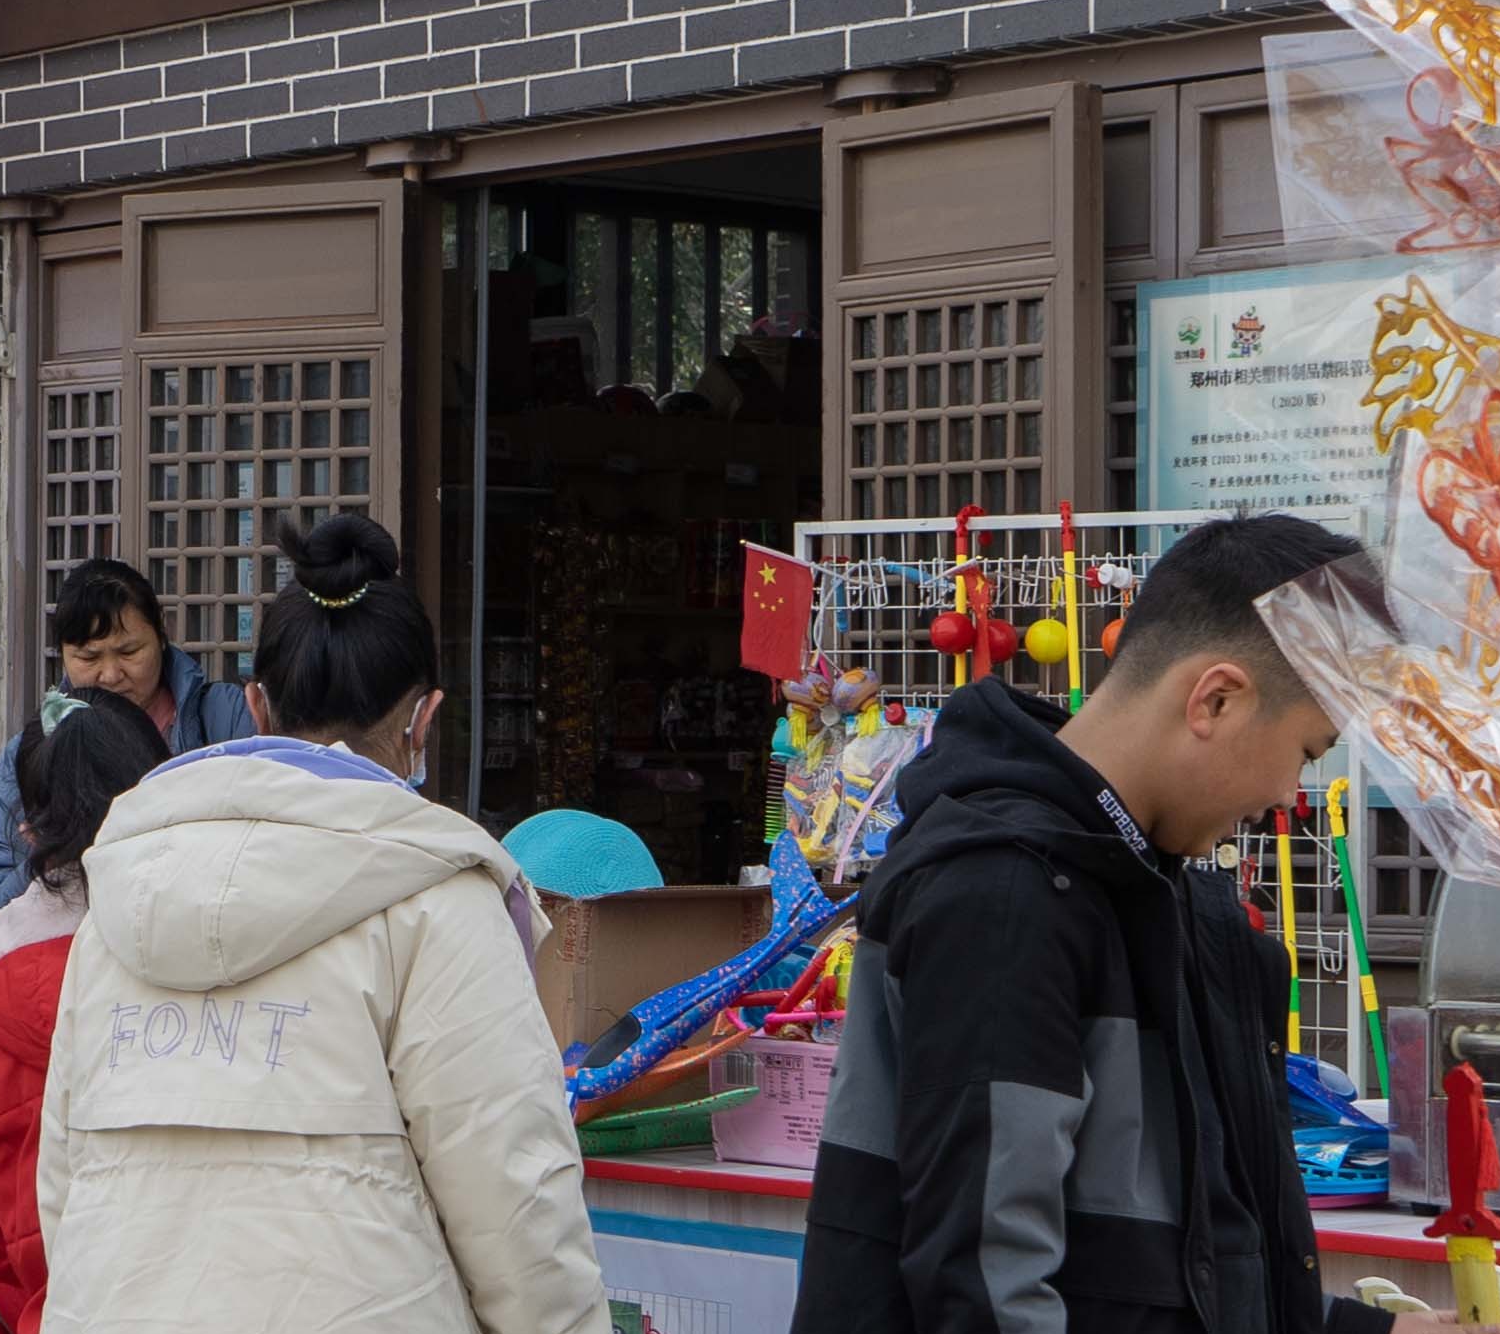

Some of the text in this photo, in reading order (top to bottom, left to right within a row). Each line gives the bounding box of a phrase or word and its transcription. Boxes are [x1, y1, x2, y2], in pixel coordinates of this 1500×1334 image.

[1190, 357, 1409, 389] 郑州市相关塑料制品禁限管
[108, 999, 312, 1072] FONT
